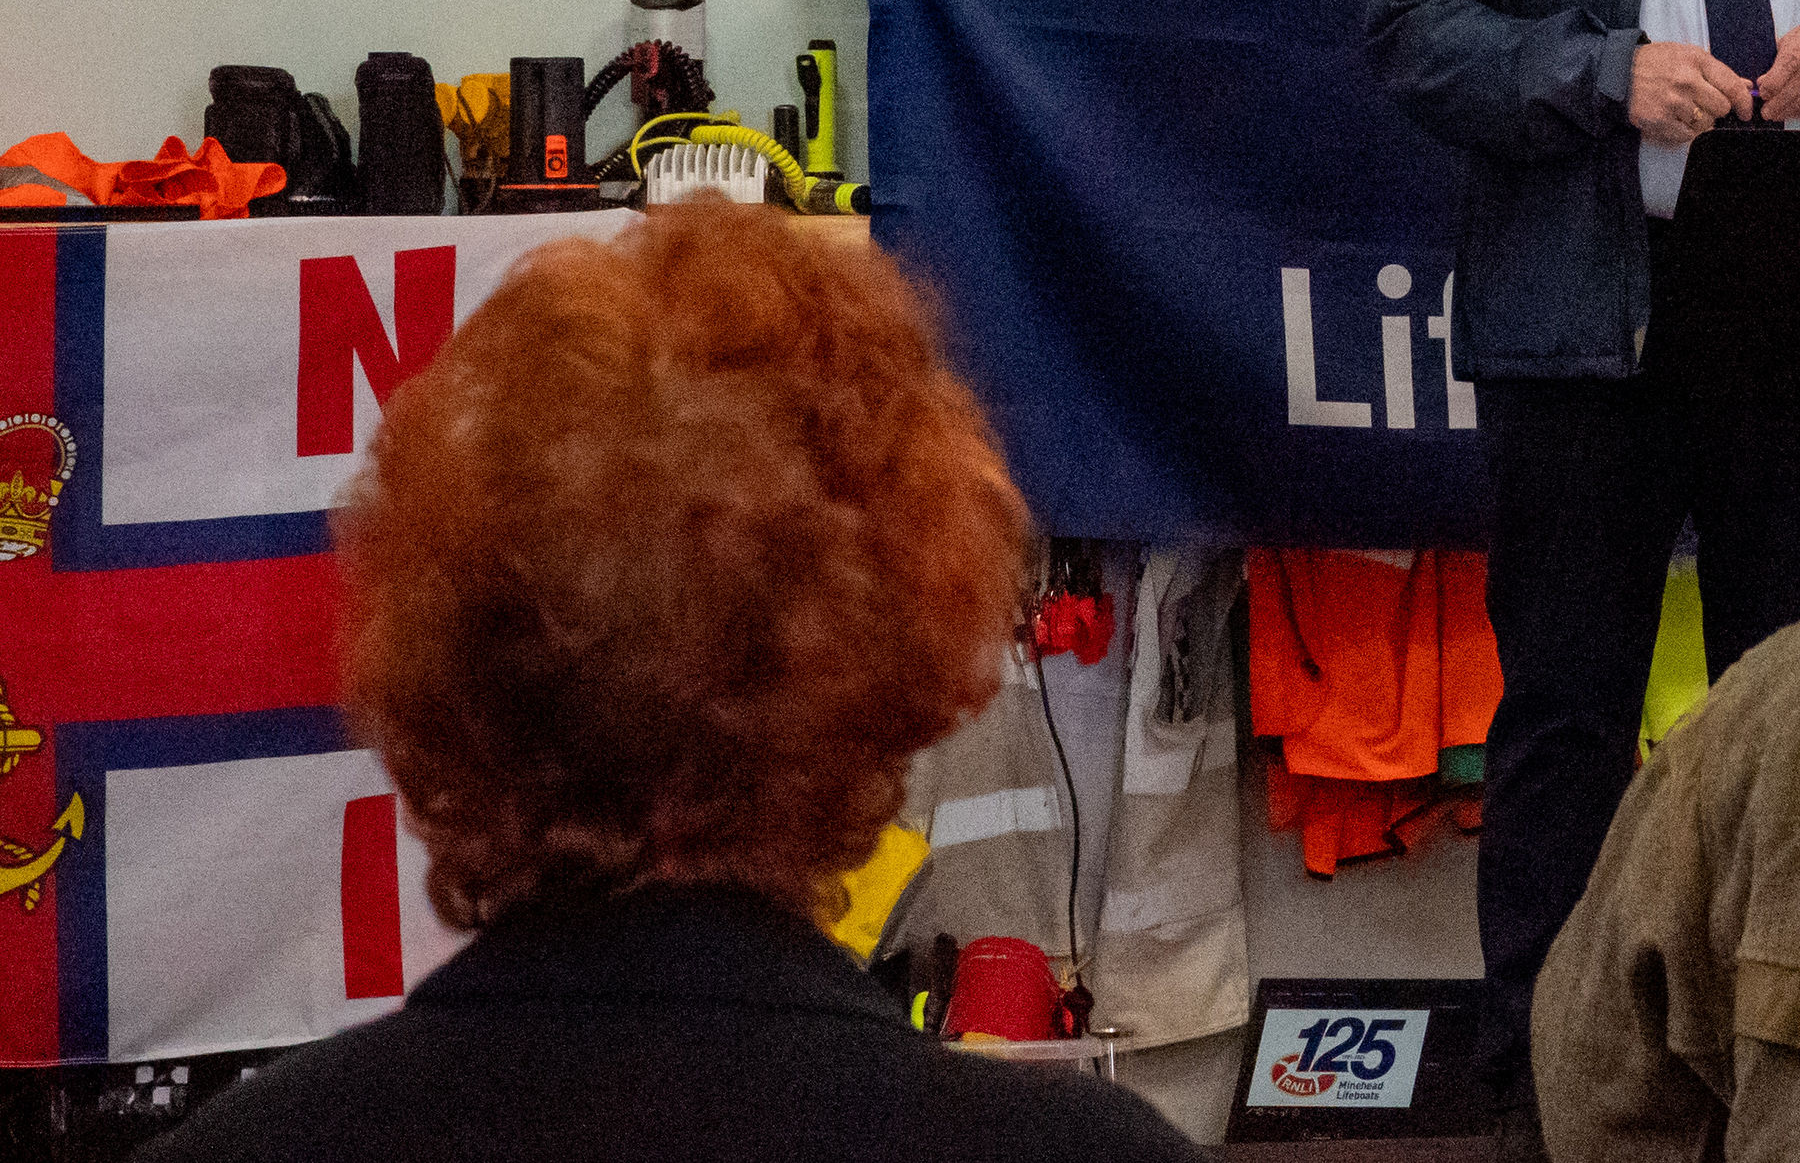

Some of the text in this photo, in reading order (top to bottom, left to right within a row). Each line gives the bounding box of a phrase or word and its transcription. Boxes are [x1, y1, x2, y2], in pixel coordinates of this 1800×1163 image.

[297, 244, 456, 458] N
[1296, 1016, 1407, 1081] 125
[1281, 1078, 1315, 1094] RNLI
[1338, 1081, 1384, 1092] Minehead
[1336, 1090, 1380, 1101] Lifeboats
